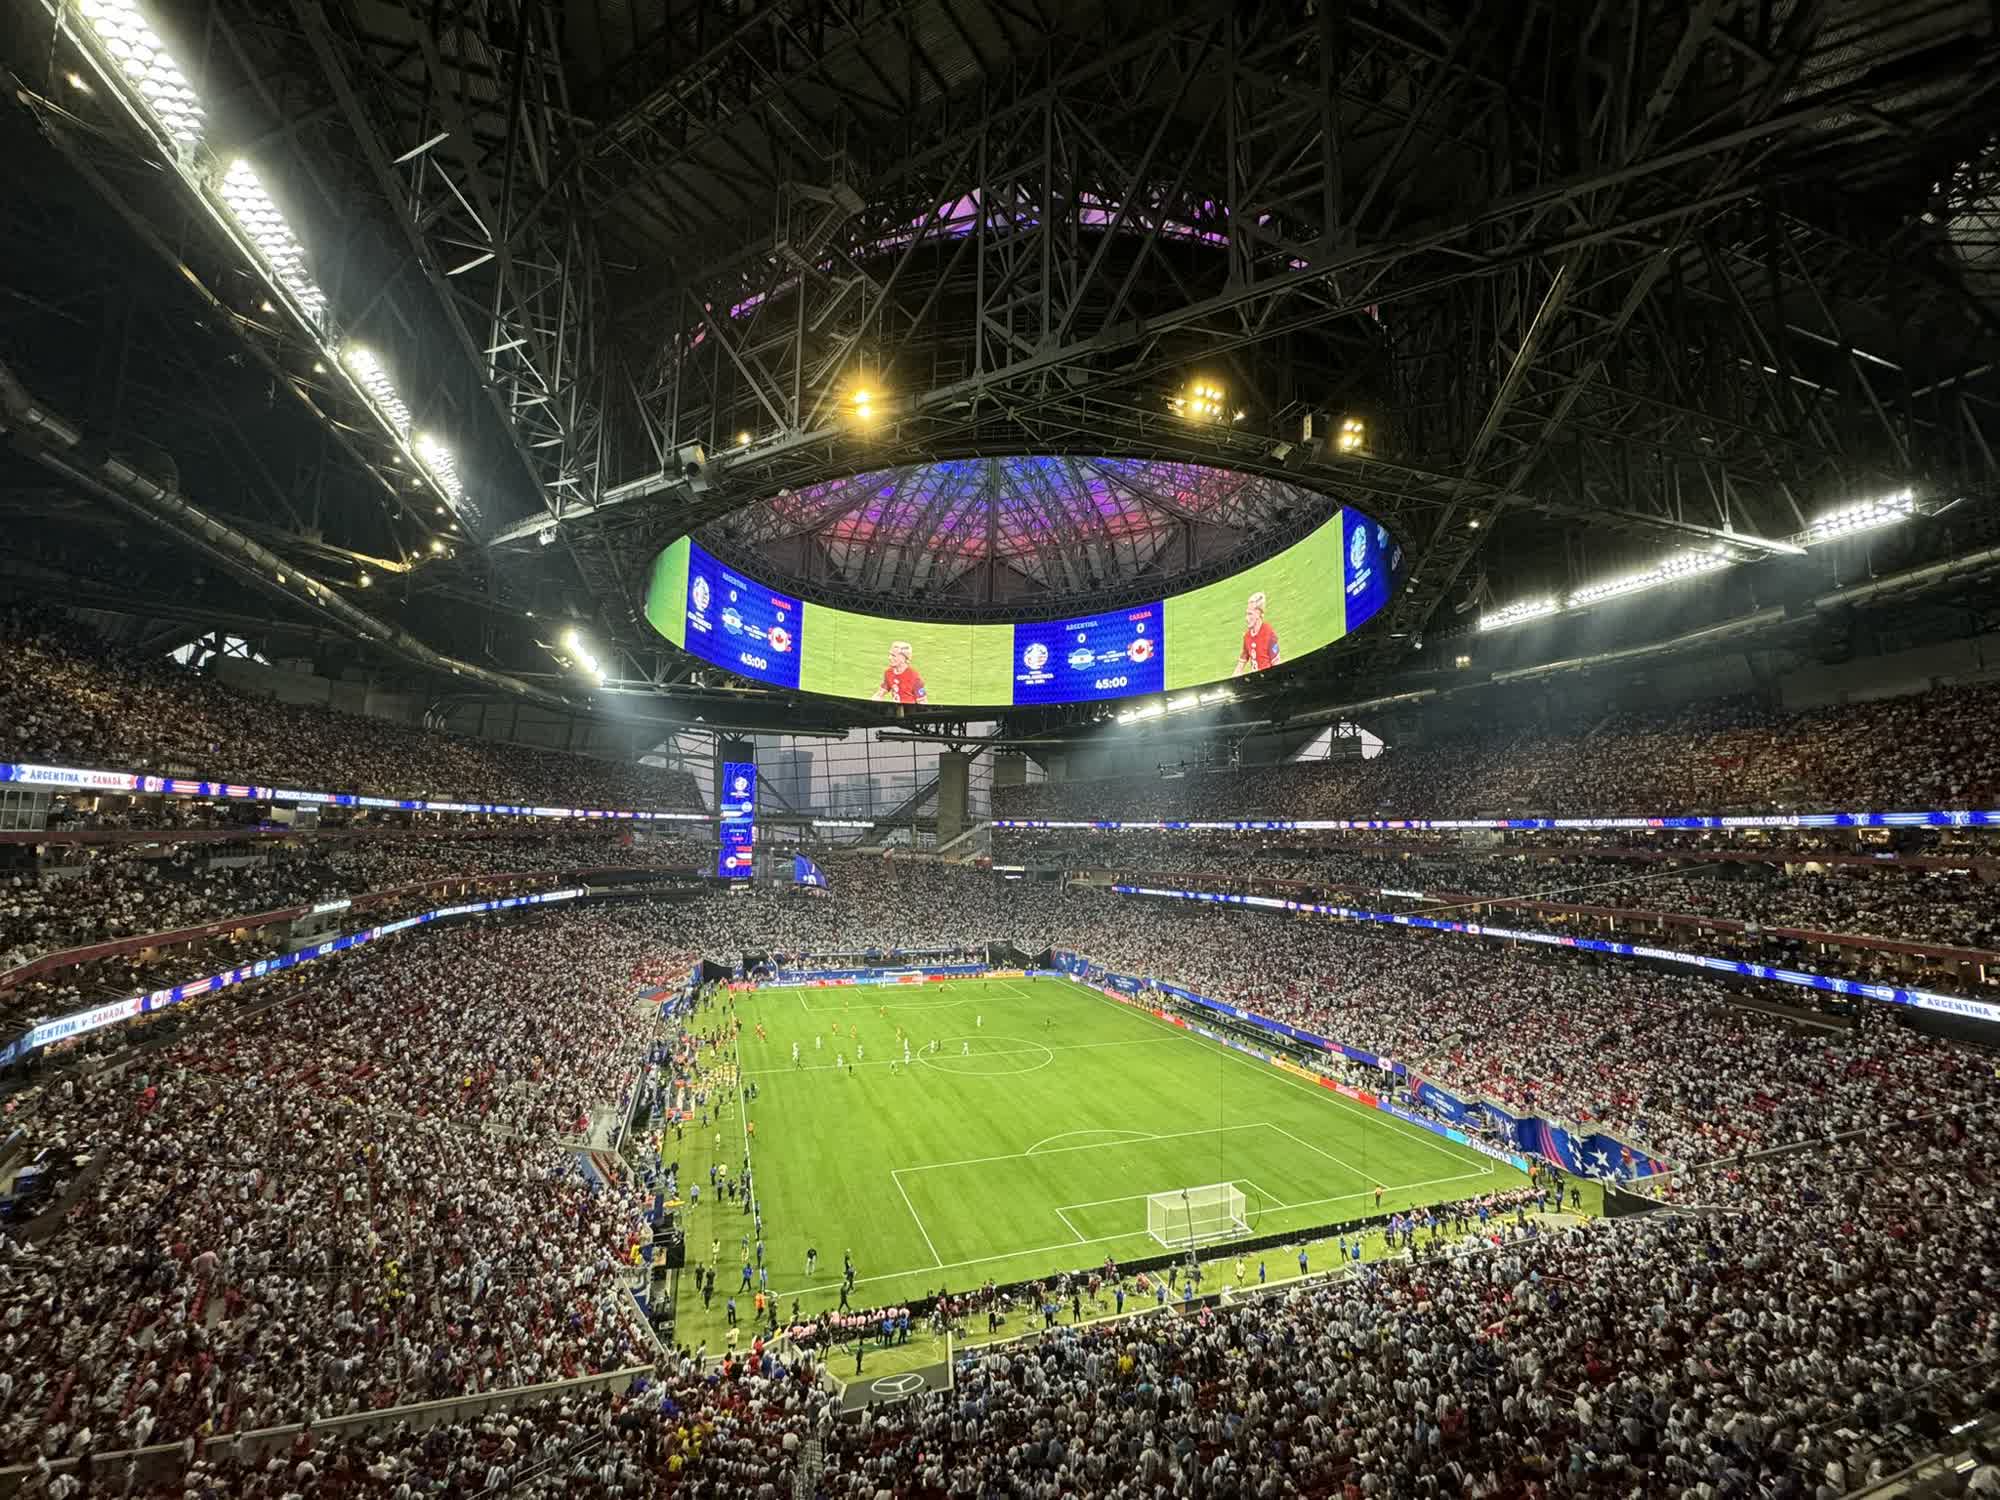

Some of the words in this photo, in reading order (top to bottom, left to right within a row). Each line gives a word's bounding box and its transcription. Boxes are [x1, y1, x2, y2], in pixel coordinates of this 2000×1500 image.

[730, 590, 737, 602] 0
[776, 611, 785, 622] 0
[1136, 623, 1145, 633] 0
[1077, 633, 1086, 643] 0
[740, 652, 767, 671] 45:00
[1095, 676, 1128, 690] 45:00
[30, 769, 79, 783] ARGENTINA
[92, 775, 122, 786] CANADA
[1554, 819, 1592, 827] CONMEBOL
[1592, 818, 1613, 827] COPA
[1612, 818, 1648, 827] AMERICA
[1648, 818, 1664, 827] USA
[1721, 817, 1764, 826] CONMEBOL
[1633, 946, 1677, 960] CONMEBOL
[1676, 953, 1697, 964] COPA
[1927, 998, 1991, 1016] ARGENTINA
[92, 1006, 125, 1023] CANADA
[1472, 1140, 1512, 1165] Rexona
